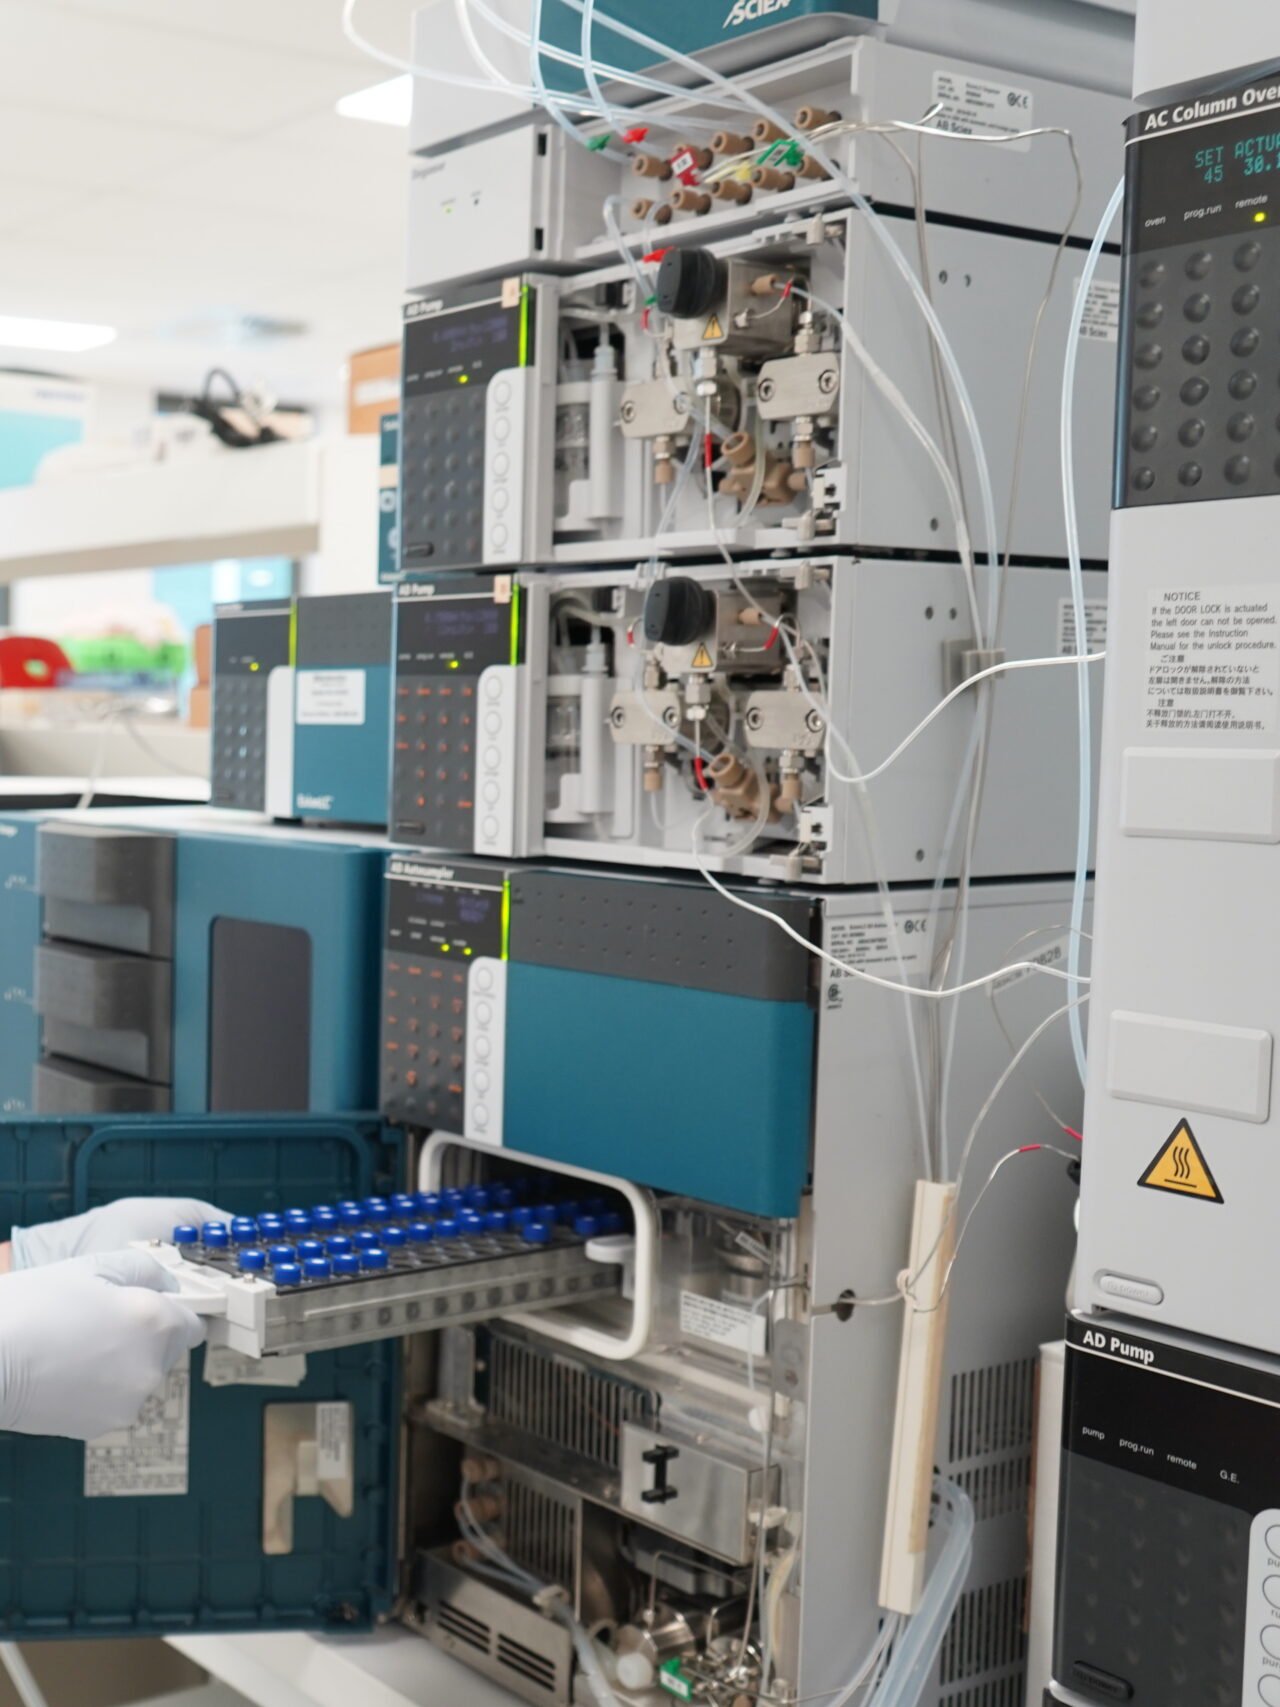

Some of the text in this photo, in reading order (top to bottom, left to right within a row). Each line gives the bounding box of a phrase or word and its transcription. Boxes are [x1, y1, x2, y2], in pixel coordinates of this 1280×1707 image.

[1144, 85, 1280, 131] AC Column Ove
[1194, 146, 1224, 168] SET
[1203, 164, 1224, 184] 45
[1144, 194, 1268, 228] oven prog.run remote
[1164, 591, 1201, 602] NOTICE
[1160, 606, 1171, 615] the
[1175, 604, 1197, 615] DOOR
[1201, 604, 1221, 614] LOCK
[1225, 604, 1230, 613] is
[1234, 603, 1268, 613] actuated
[1152, 619, 1162, 627] the
[1166, 619, 1177, 627] left
[1180, 618, 1197, 626] door
[1217, 617, 1230, 626] not
[1233, 617, 1242, 625] be
[1246, 615, 1277, 626] opened.
[1150, 629, 1248, 639] Please see the Instruction
[1150, 640, 1277, 651] Manual for the unlock procedure.
[1082, 1330, 1155, 1366] AD Pump
[1082, 1426, 1240, 1484] pump prog.run remote G.E.
